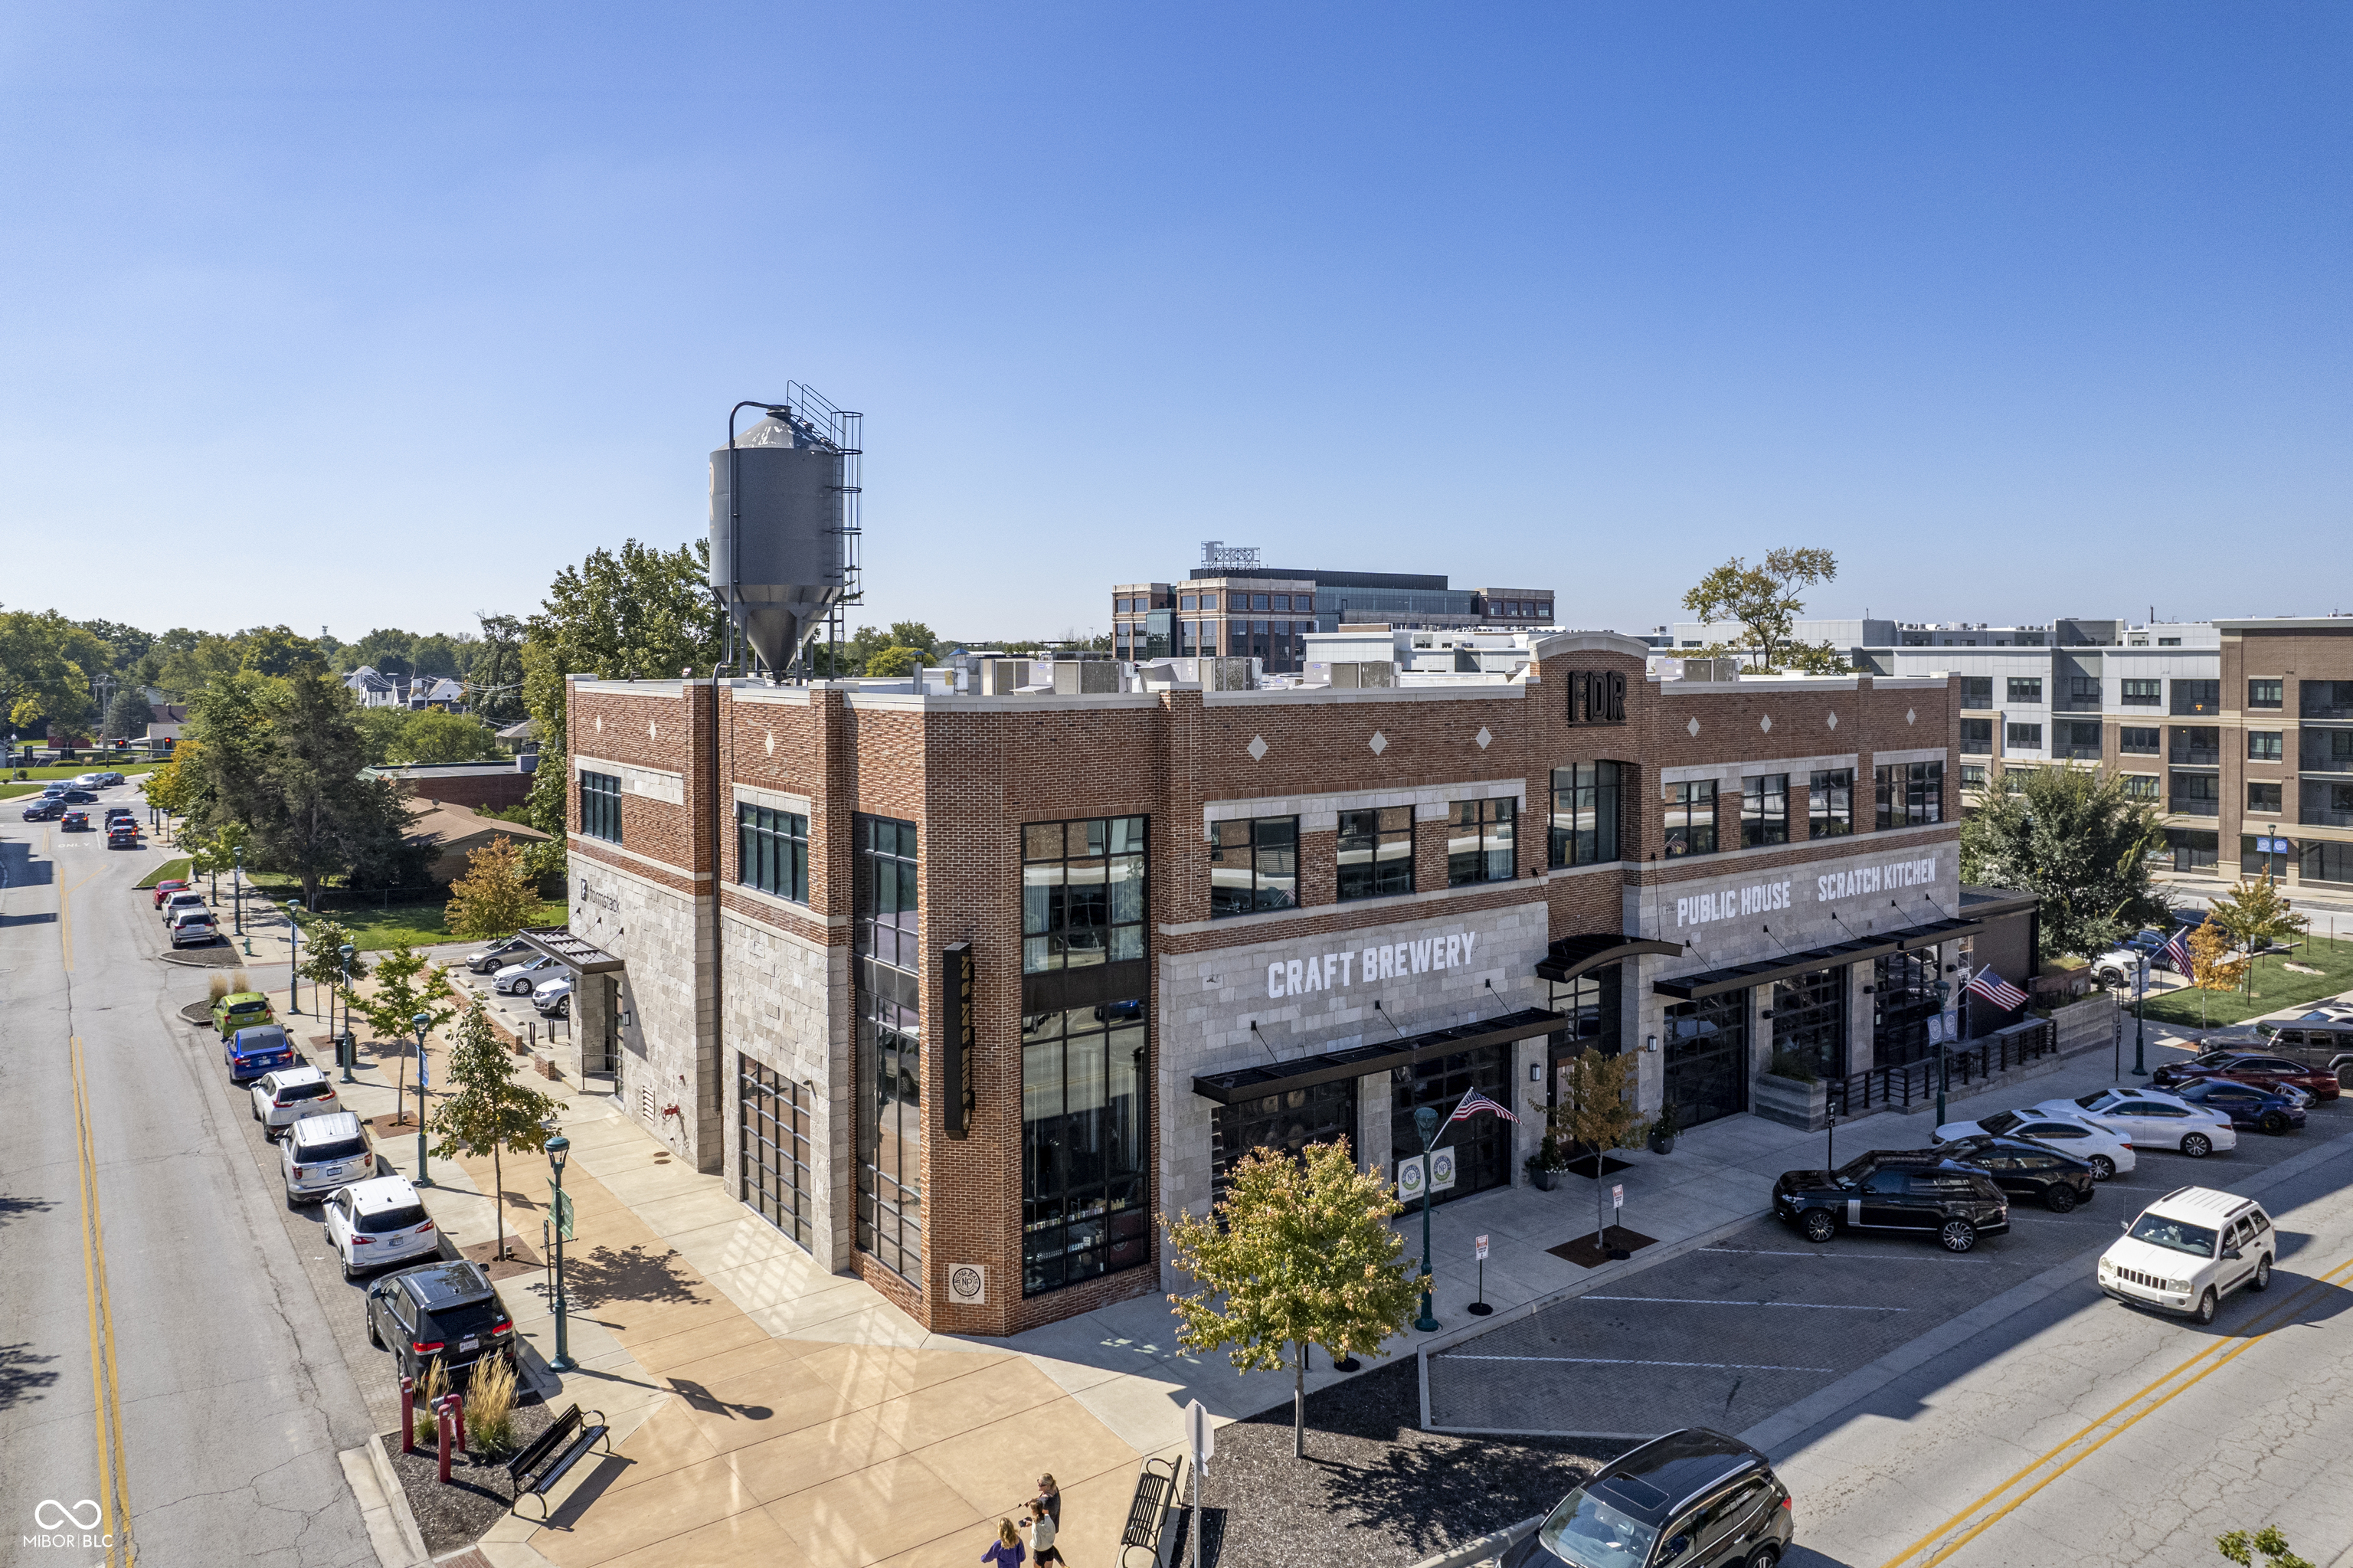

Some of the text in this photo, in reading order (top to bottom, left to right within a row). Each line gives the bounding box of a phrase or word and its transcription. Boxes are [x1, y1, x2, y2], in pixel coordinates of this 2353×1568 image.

[1568, 670, 1627, 722] FDR
[1818, 858, 1936, 902] SCRATCH KITCHEN
[589, 884, 620, 915] formstack
[1677, 881, 1791, 927] PUBLIC HOUSE
[1268, 931, 1475, 999] CRAFT BREWERY
[961, 955, 970, 1105] FOUR DAY RAY
[1407, 1172, 1415, 1183] NP
[1438, 1164, 1447, 1174] NP
[954, 1270, 979, 1285] NICKEL PLATE
[961, 1276, 973, 1288] NP
